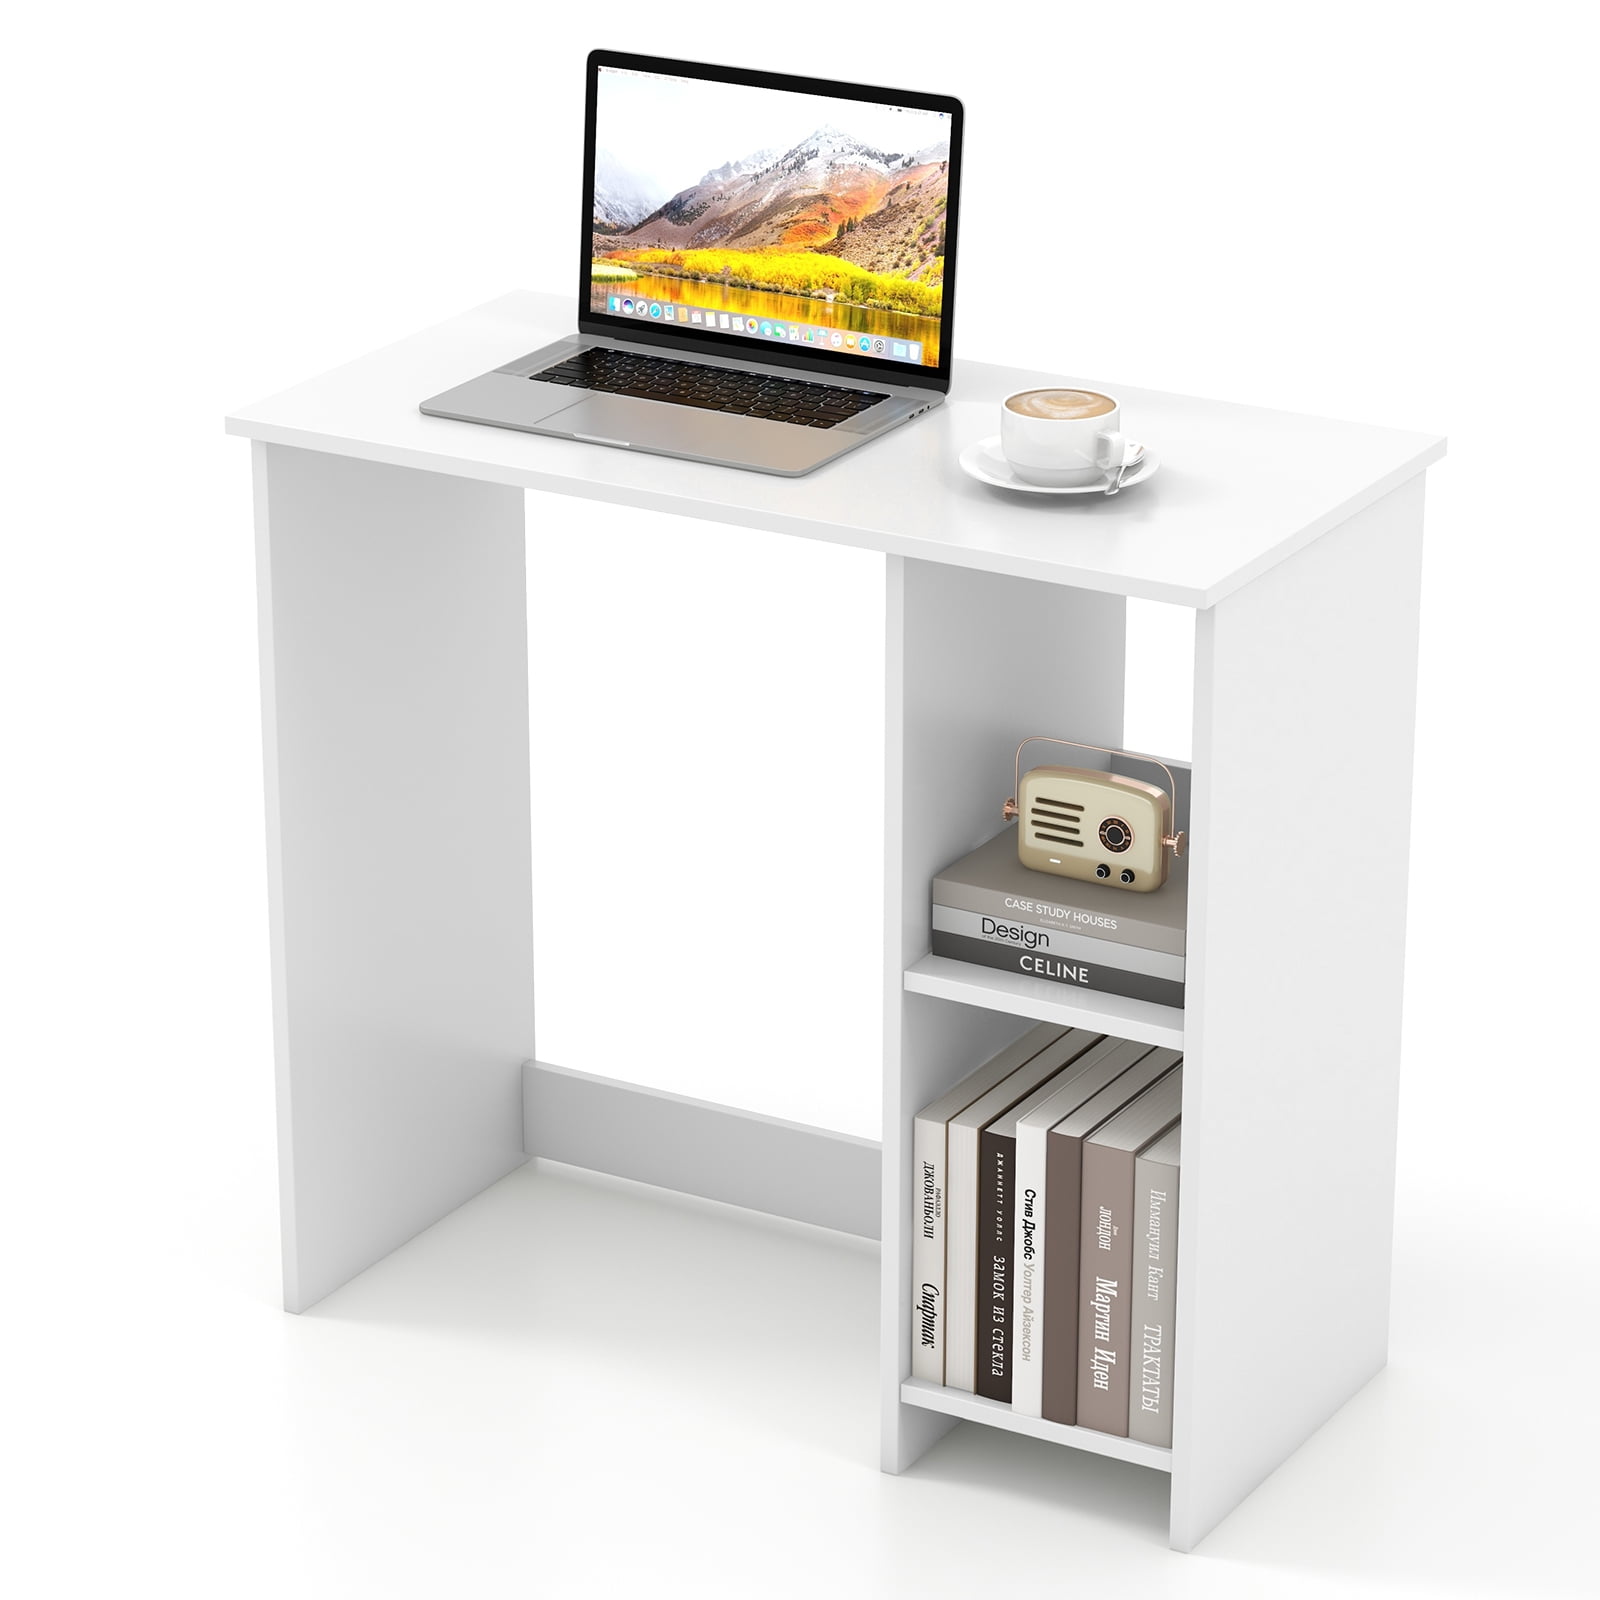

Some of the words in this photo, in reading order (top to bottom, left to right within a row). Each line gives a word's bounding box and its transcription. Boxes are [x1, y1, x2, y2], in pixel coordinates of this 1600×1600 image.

[982, 917, 1050, 949] Design
[1004, 897, 1034, 912] CASE
[1035, 903, 1072, 920] STUDY
[1073, 912, 1118, 930] HOUSES
[1019, 955, 1089, 984] CELINE
[923, 1161, 935, 1239] ДЖОВАНЬОЛИ
[1024, 1188, 1037, 1218] Стив
[1022, 1218, 1036, 1260] Джобс
[1096, 1205, 1112, 1251] ЛОНДОН
[1146, 1188, 1167, 1260] Иммануил
[1020, 1263, 1035, 1304] Уолтер
[1148, 1265, 1164, 1301] Кант
[916, 1283, 940, 1349] Спартак
[1090, 1276, 1118, 1342] Мартин
[1021, 1306, 1034, 1361] Айзексон
[1090, 1346, 1117, 1391] Иден
[1141, 1323, 1163, 1414] ТРАКТАТЫ
